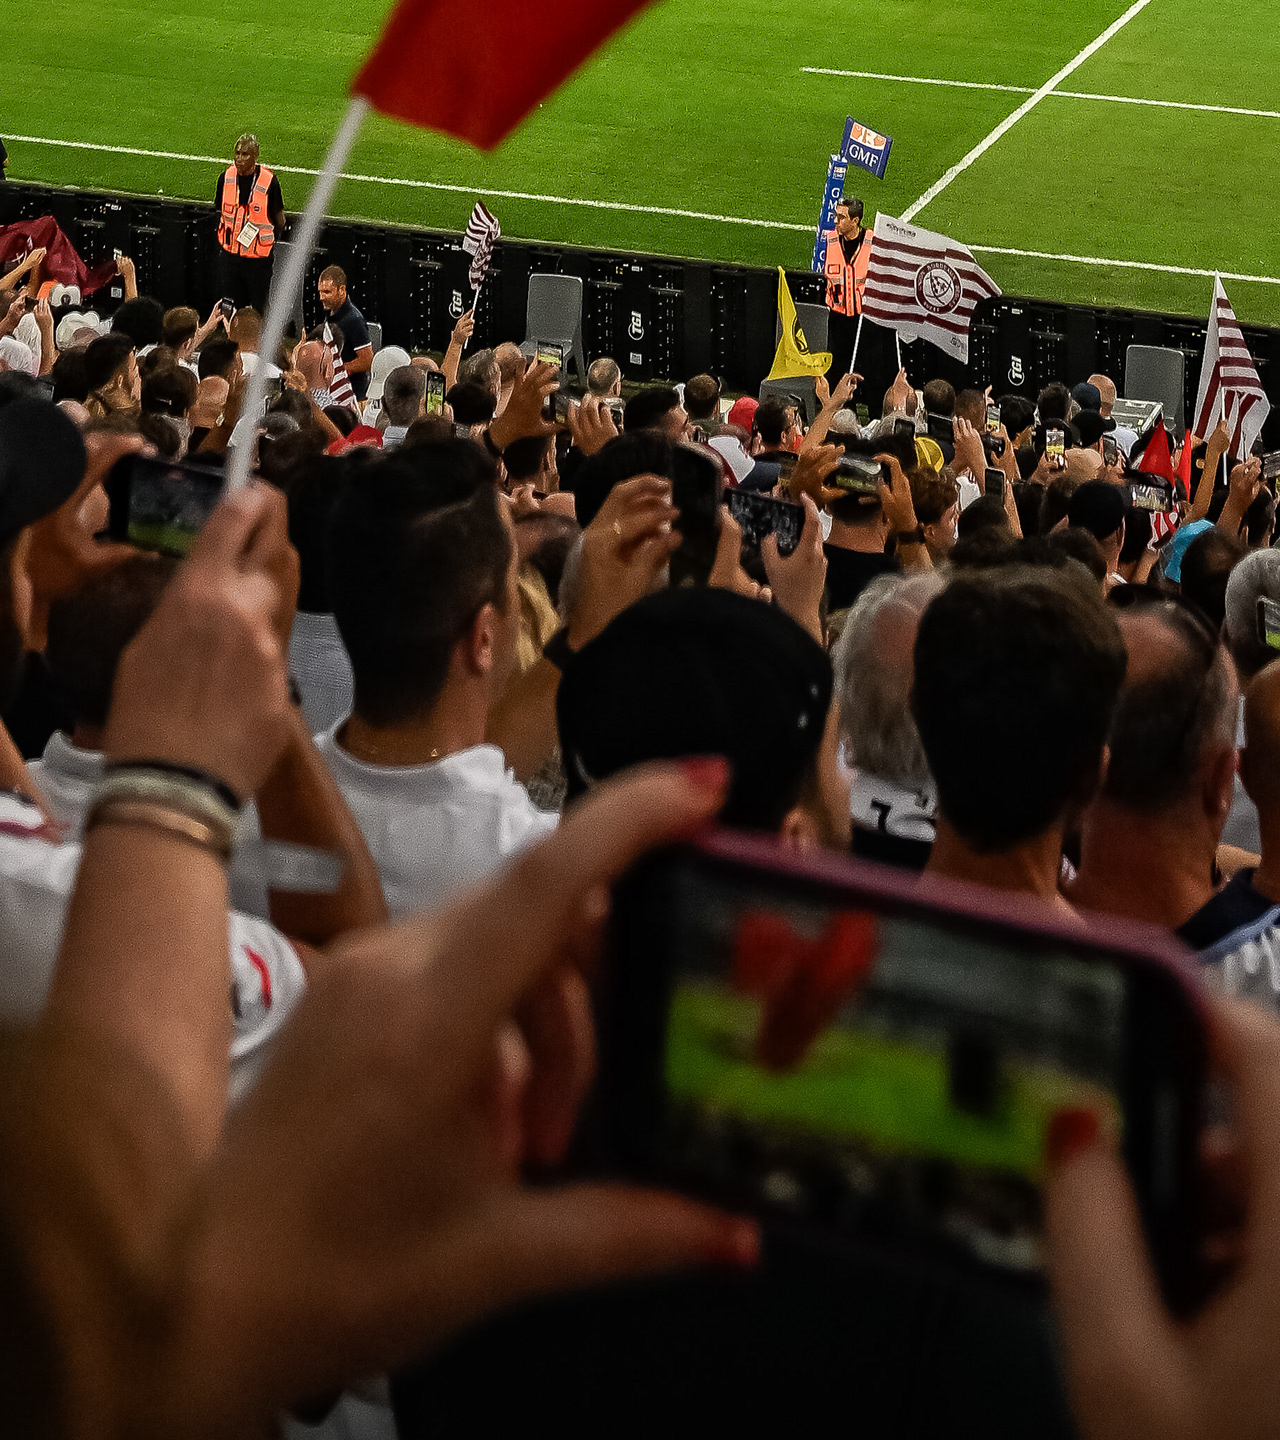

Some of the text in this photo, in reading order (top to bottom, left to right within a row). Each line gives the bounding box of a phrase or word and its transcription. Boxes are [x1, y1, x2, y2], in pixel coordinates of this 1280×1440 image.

[848, 144, 879, 168] GMF
[452, 290, 462, 312] TGI
[632, 311, 642, 334] TGI
[1012, 356, 1022, 379] TGI
